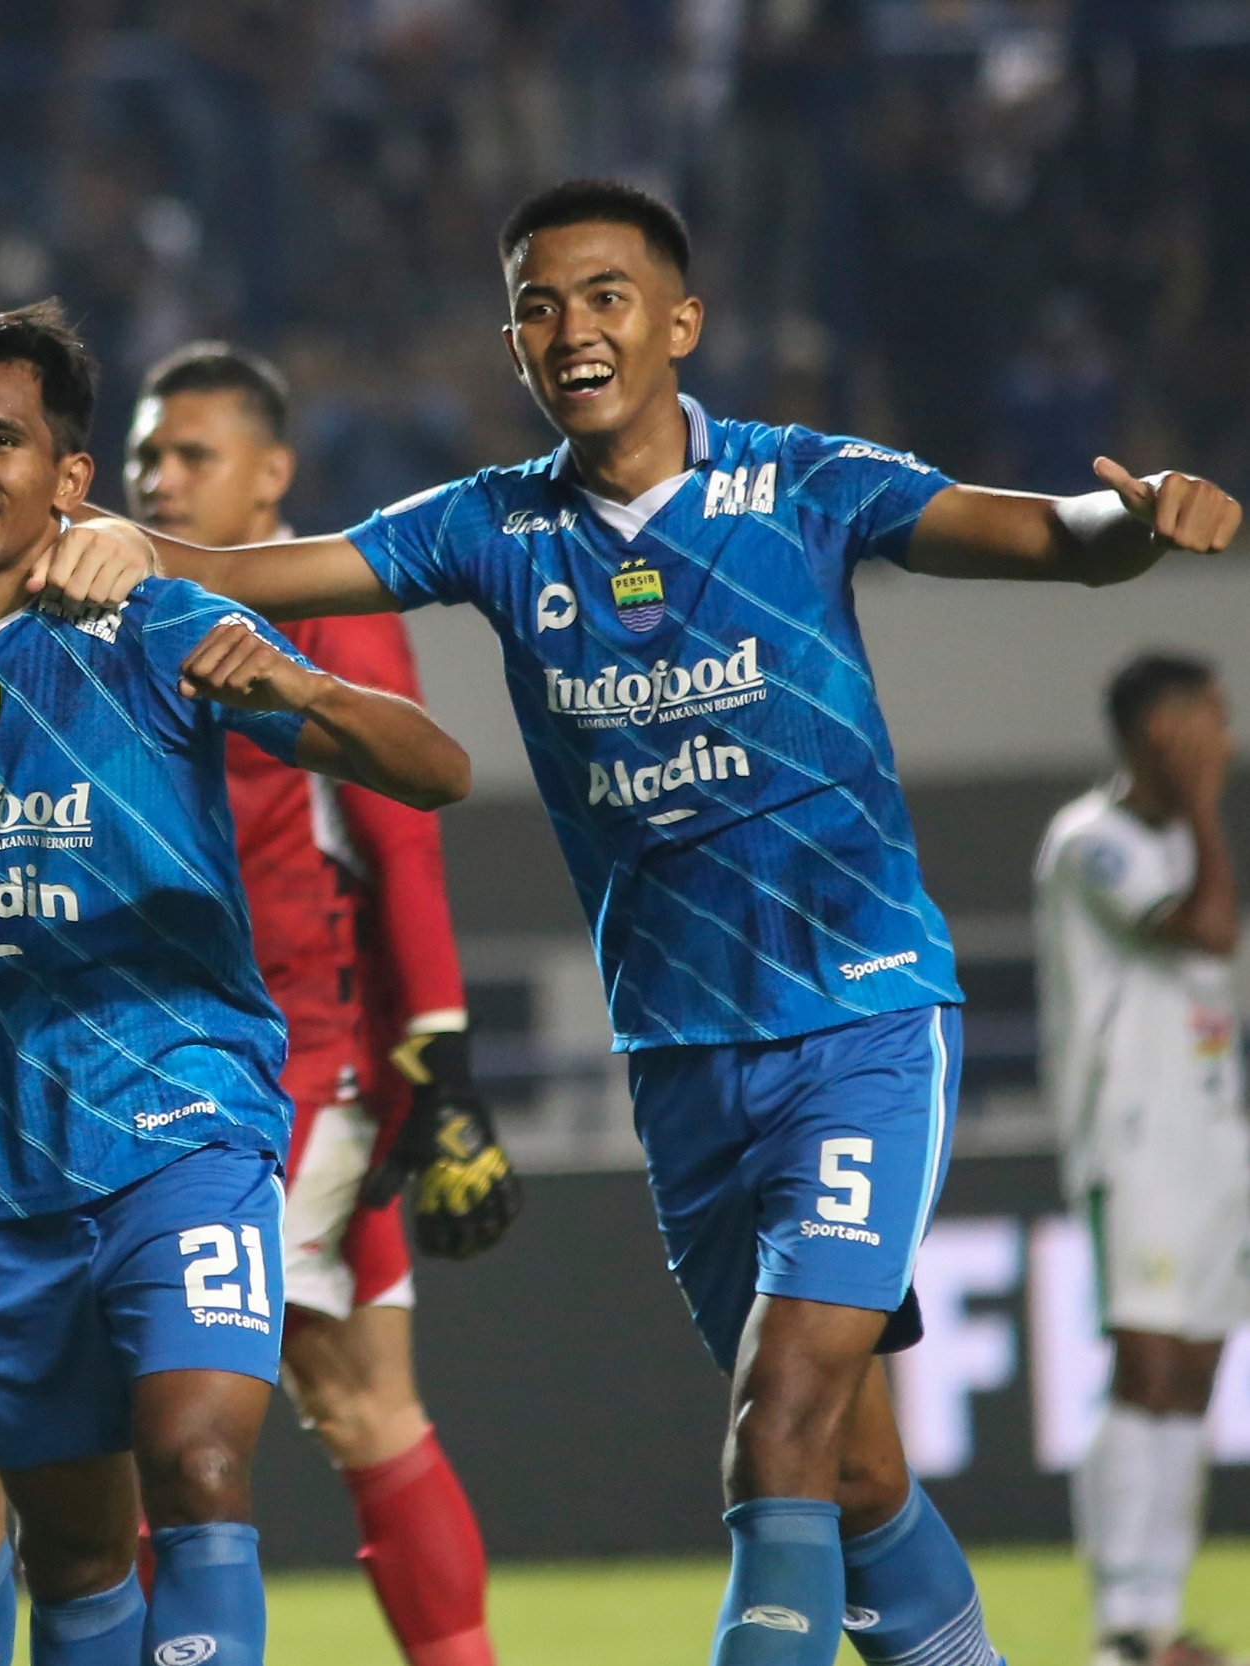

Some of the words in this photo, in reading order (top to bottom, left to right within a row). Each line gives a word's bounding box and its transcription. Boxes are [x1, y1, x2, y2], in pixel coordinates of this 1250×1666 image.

[616, 574, 655, 589] PERSIB
[75, 617, 117, 645] SELERA
[543, 637, 763, 726] Indofood
[577, 716, 628, 729] LAMBANG
[659, 703, 712, 724] MAKANAN
[715, 688, 767, 712] BERMUTU
[588, 735, 751, 807] Aladin
[838, 950, 918, 981] Sportama
[133, 1101, 216, 1131] Sportama
[816, 1137, 873, 1226] 5
[800, 1219, 881, 1247] Sportama
[178, 1224, 271, 1318] 21
[191, 1308, 270, 1335] Sportama
